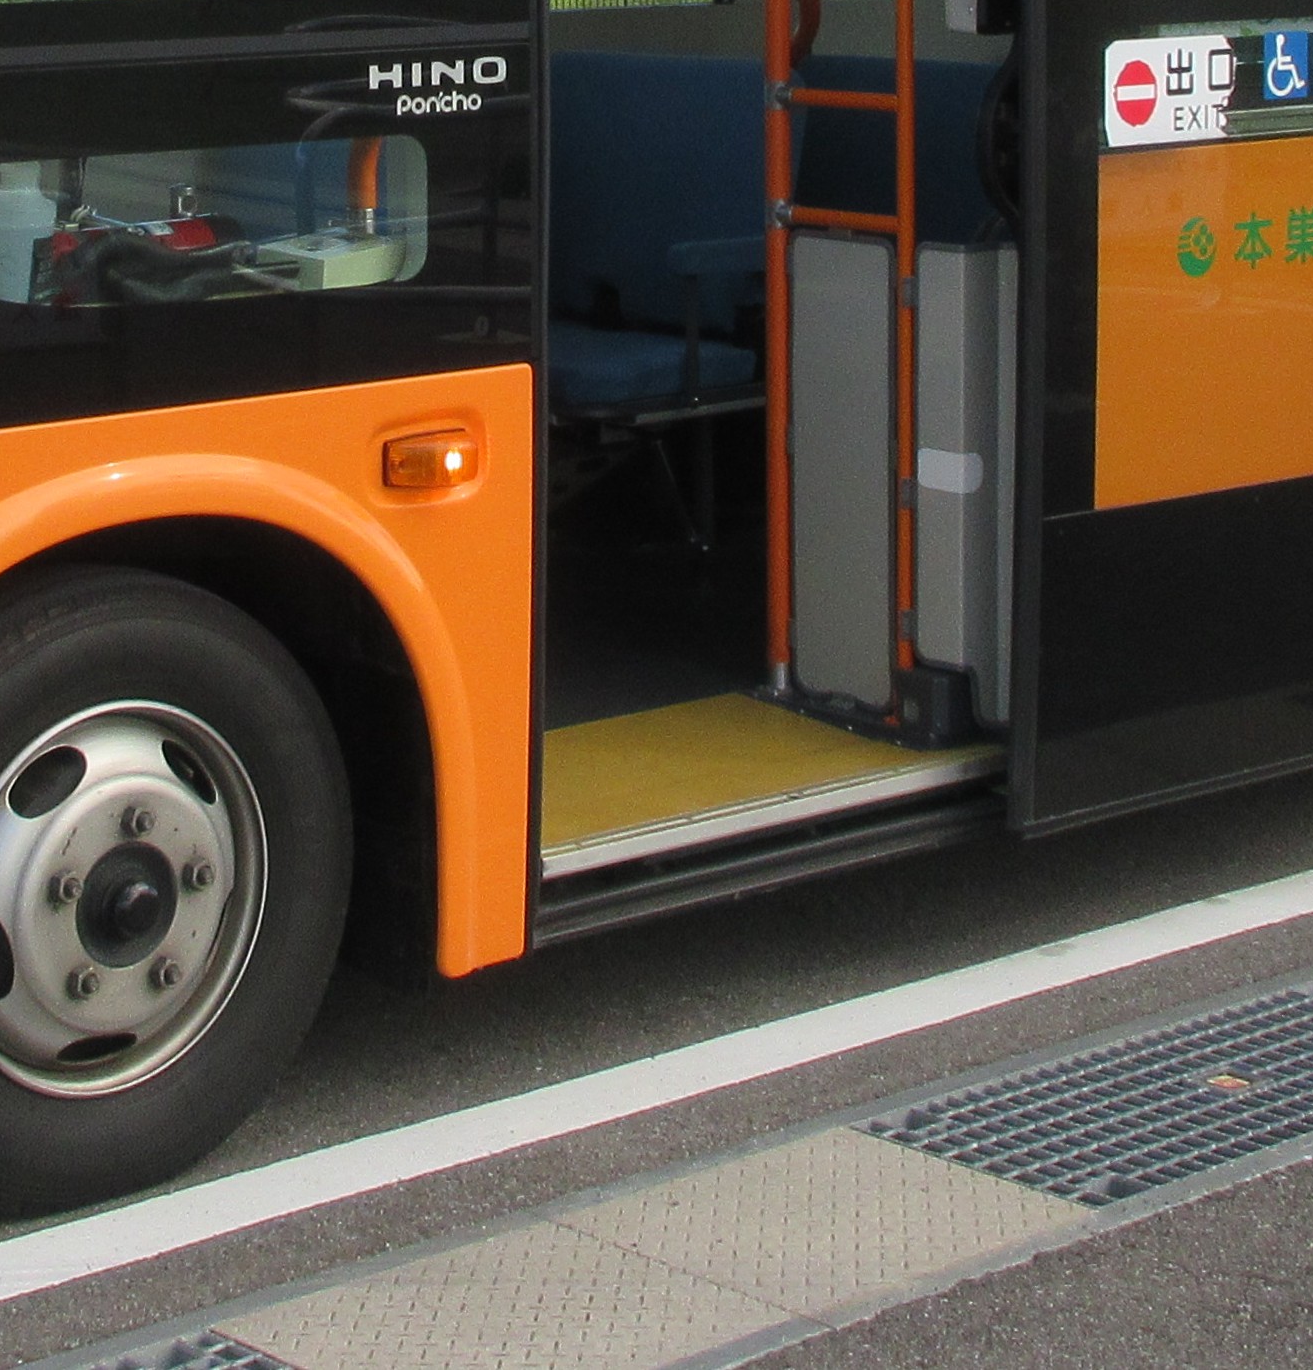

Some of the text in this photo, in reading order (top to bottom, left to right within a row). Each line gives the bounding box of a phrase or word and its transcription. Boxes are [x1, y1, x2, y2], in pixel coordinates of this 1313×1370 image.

[368, 56, 508, 89] HINO
[1165, 47, 1235, 97] 出口
[1172, 105, 1224, 131] EXIT
